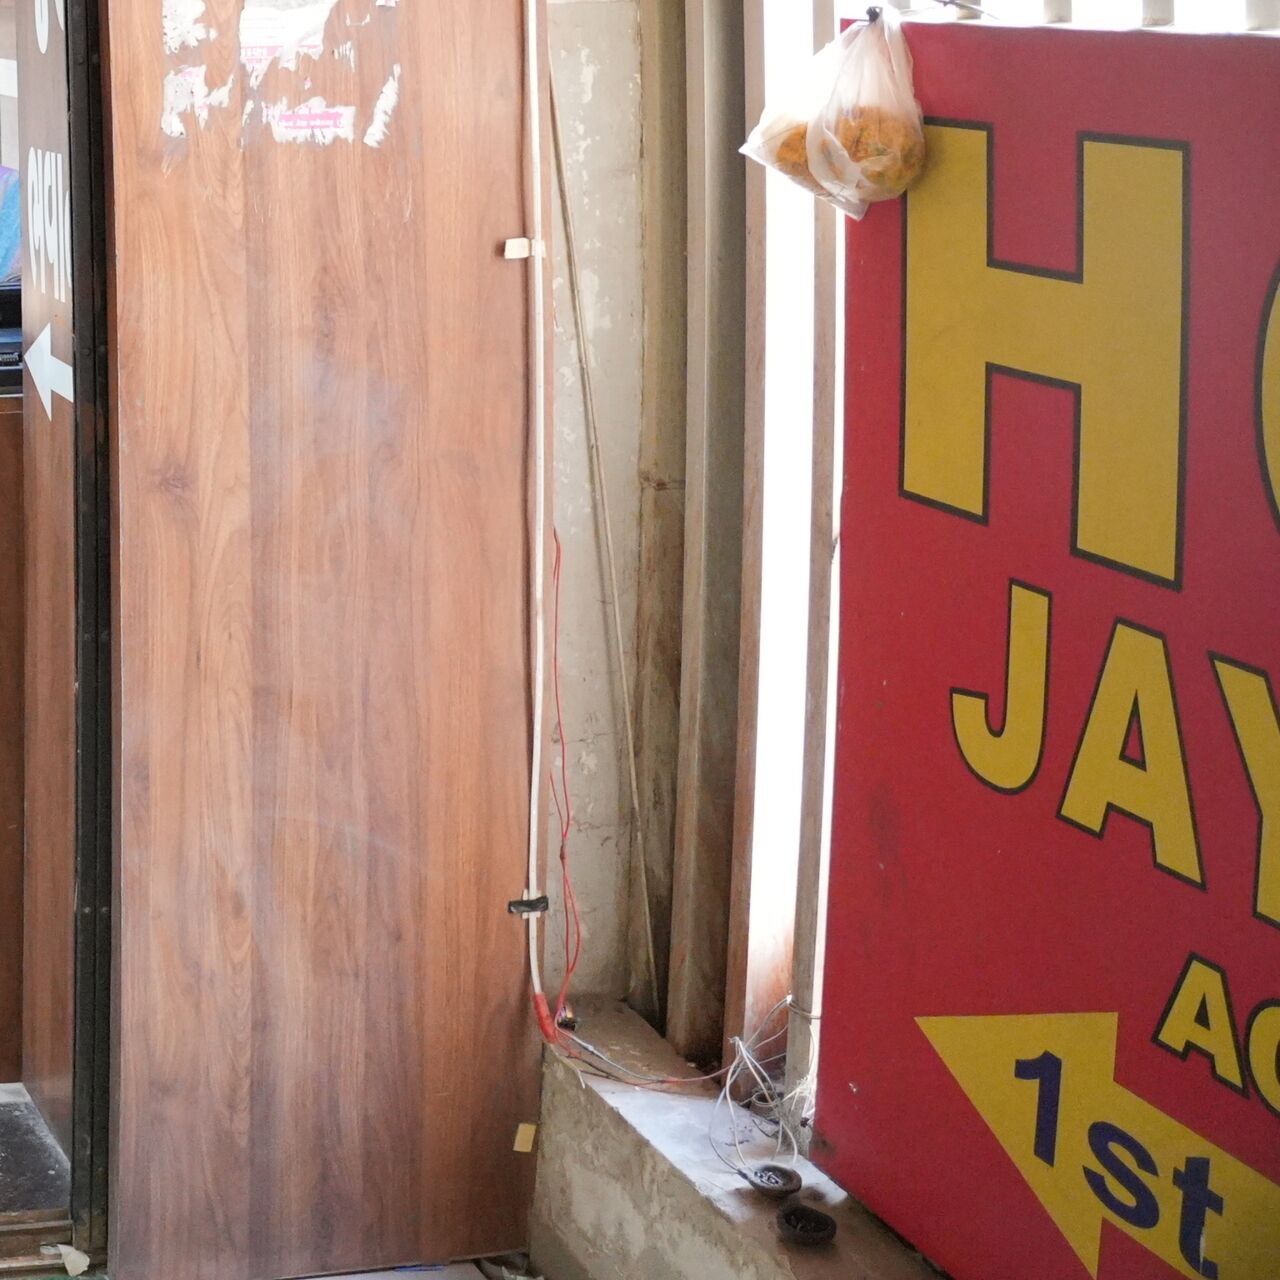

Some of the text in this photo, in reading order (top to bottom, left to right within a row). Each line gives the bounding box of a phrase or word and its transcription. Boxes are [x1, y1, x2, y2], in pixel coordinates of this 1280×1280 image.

[27, 146, 72, 303] ભવા
[898, 116, 1280, 591] H
[1013, 1048, 1225, 1280] 1st
